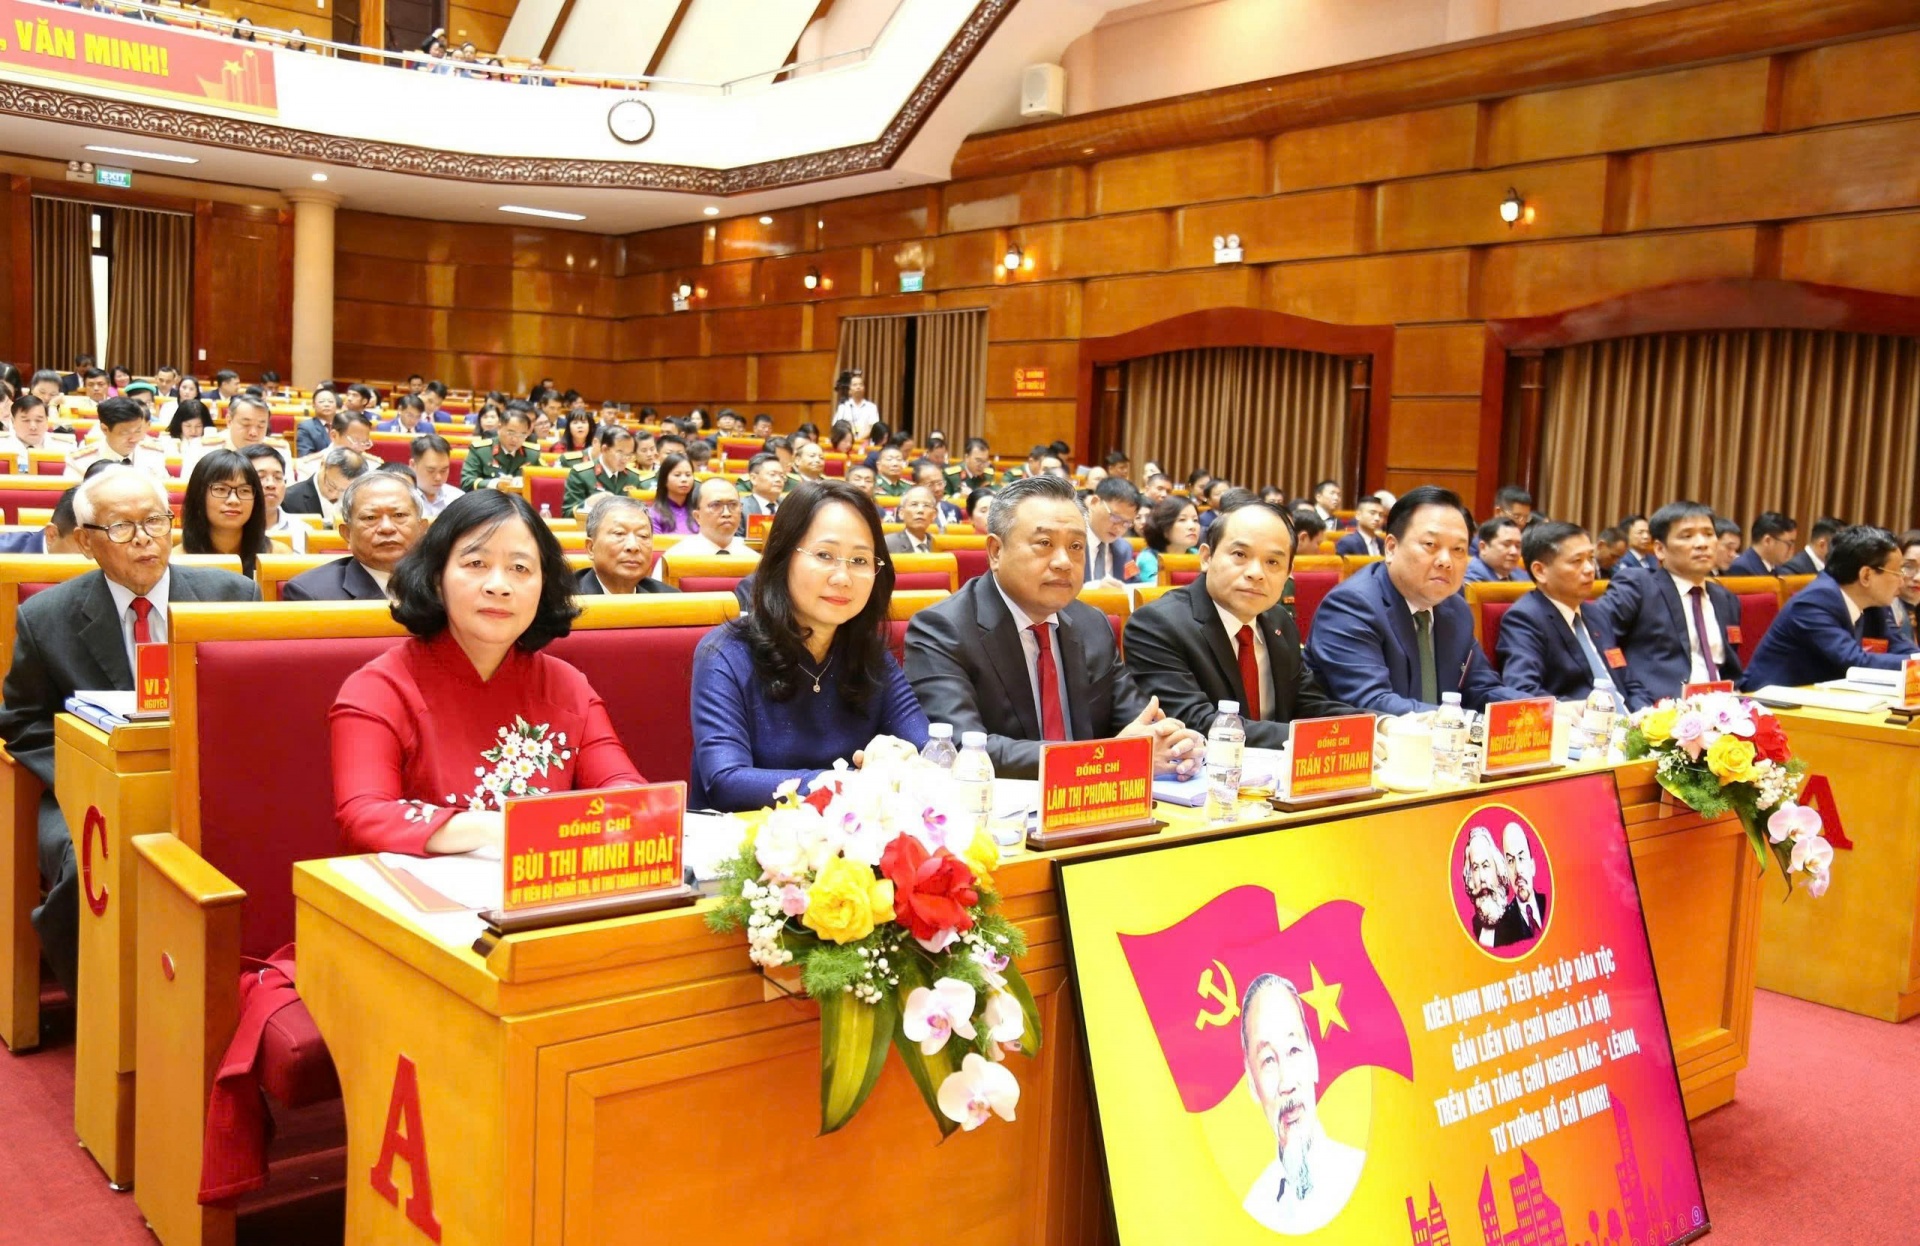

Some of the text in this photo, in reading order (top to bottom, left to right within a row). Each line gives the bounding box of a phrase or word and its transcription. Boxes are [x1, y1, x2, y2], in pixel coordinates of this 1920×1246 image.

[15, 17, 169, 77] VĂN MINH!
[101, 172, 126, 182] EXIT
[144, 678, 159, 696] VI
[1104, 760, 1120, 773] CHÍ
[1323, 751, 1336, 774] SỸ
[1338, 750, 1370, 772] THANH
[1047, 784, 1066, 811] LÂM
[1083, 781, 1117, 806] PHƯƠNG
[1119, 778, 1146, 801] THANH
[605, 816, 631, 832] CHÍ
[83, 805, 109, 917] C
[512, 832, 675, 883] BÙI THỊ MINH HOÀI
[1422, 945, 1616, 1031] KIÊN ĐỊNH MỤC TIÊU ĐỘC LẬP DÂN TỘC
[1522, 1006, 1546, 1046] CHỦ
[1545, 1001, 1579, 1037] NGHĨA
[1577, 995, 1594, 1027] XÃ
[1592, 989, 1612, 1024] HỘI
[1434, 1088, 1468, 1128] TRÊN
[1491, 1067, 1523, 1105] TẢNG
[1521, 1053, 1546, 1094] CHỦ
[1544, 1047, 1579, 1085] NGHĨA
[1576, 1038, 1602, 1072] MÁC
[1606, 1028, 1641, 1061] LÊNIN,
[1490, 1083, 1611, 1155] TƯ TƯỞNG HỒ CHÍ MINH!
[371, 1053, 442, 1246] A
